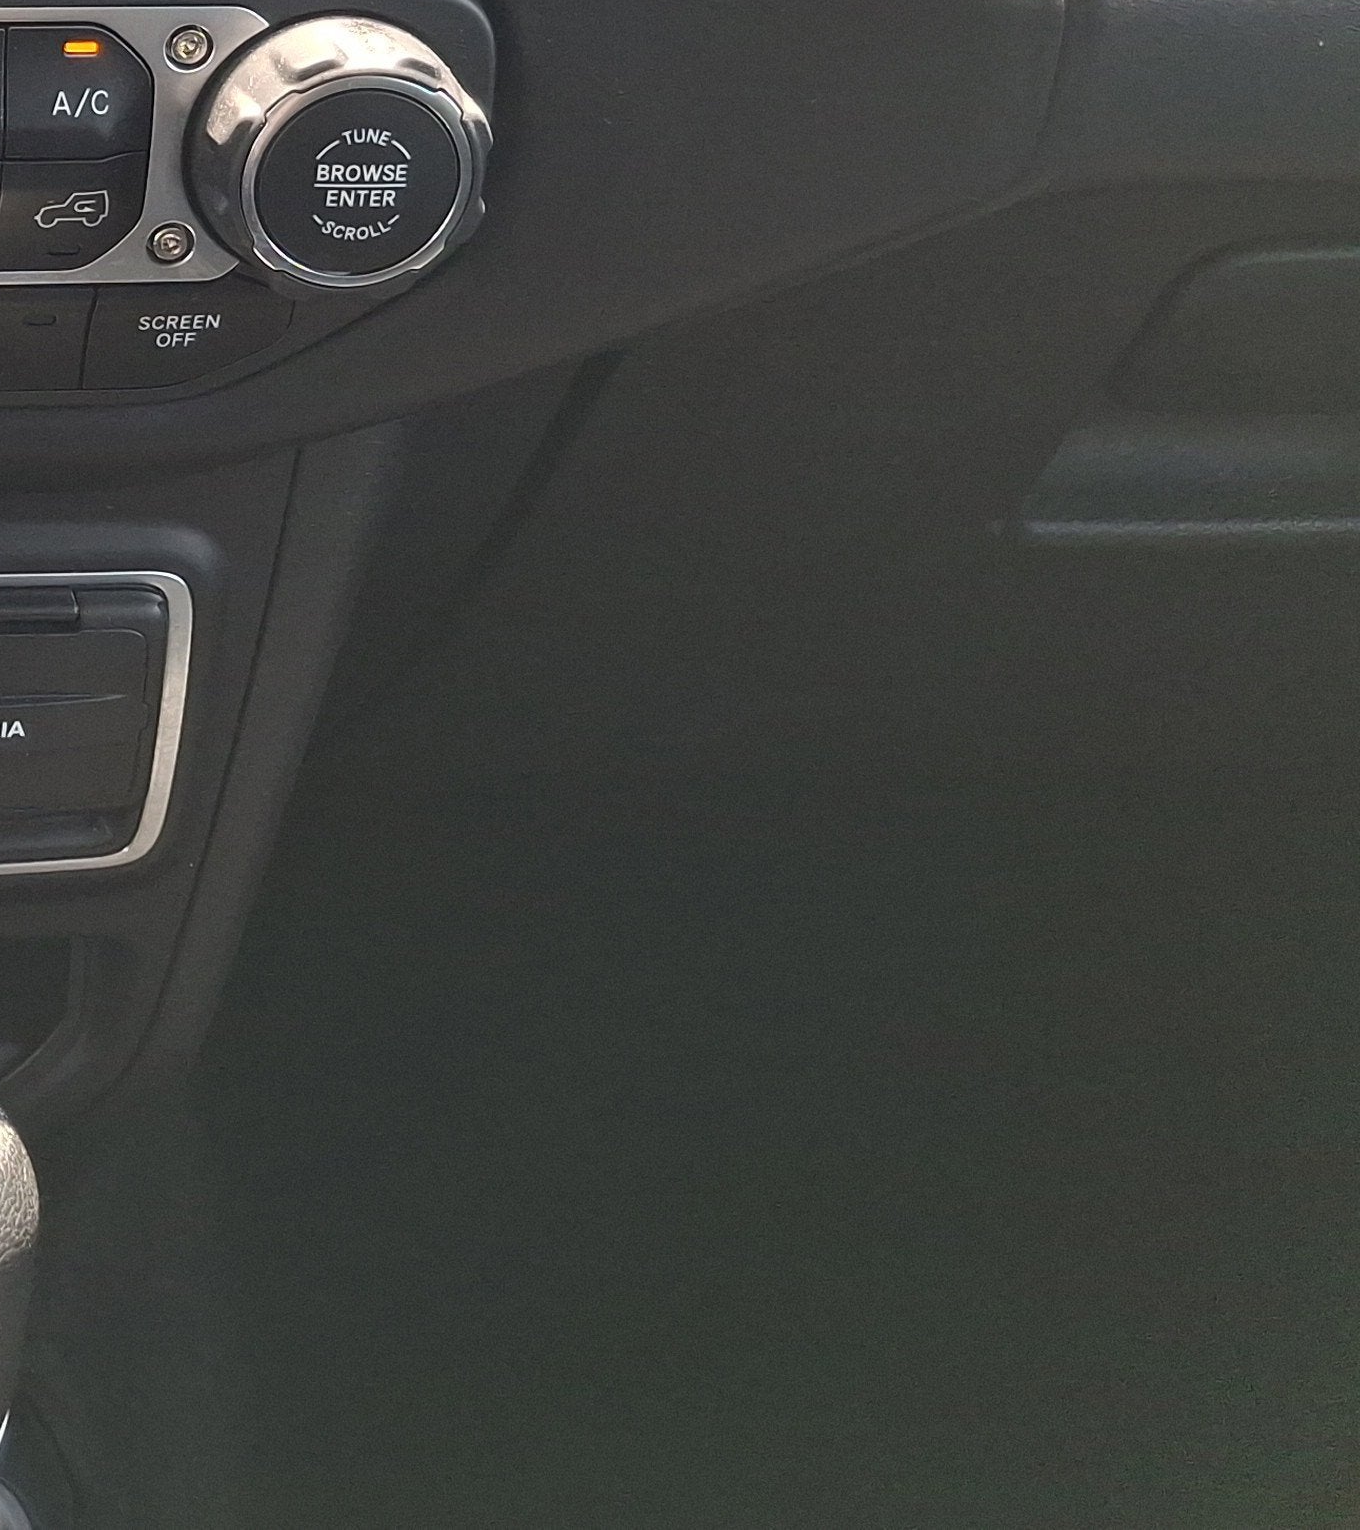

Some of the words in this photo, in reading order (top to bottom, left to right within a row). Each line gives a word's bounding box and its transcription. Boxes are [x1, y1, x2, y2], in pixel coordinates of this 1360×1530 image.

[51, 89, 110, 118] A/C
[340, 128, 393, 150] TUNE
[315, 163, 408, 183] BROWSE
[325, 189, 397, 209] ENTER
[320, 217, 393, 243] SCROLL
[137, 313, 222, 331] SCREEN
[154, 332, 197, 348] OFF
